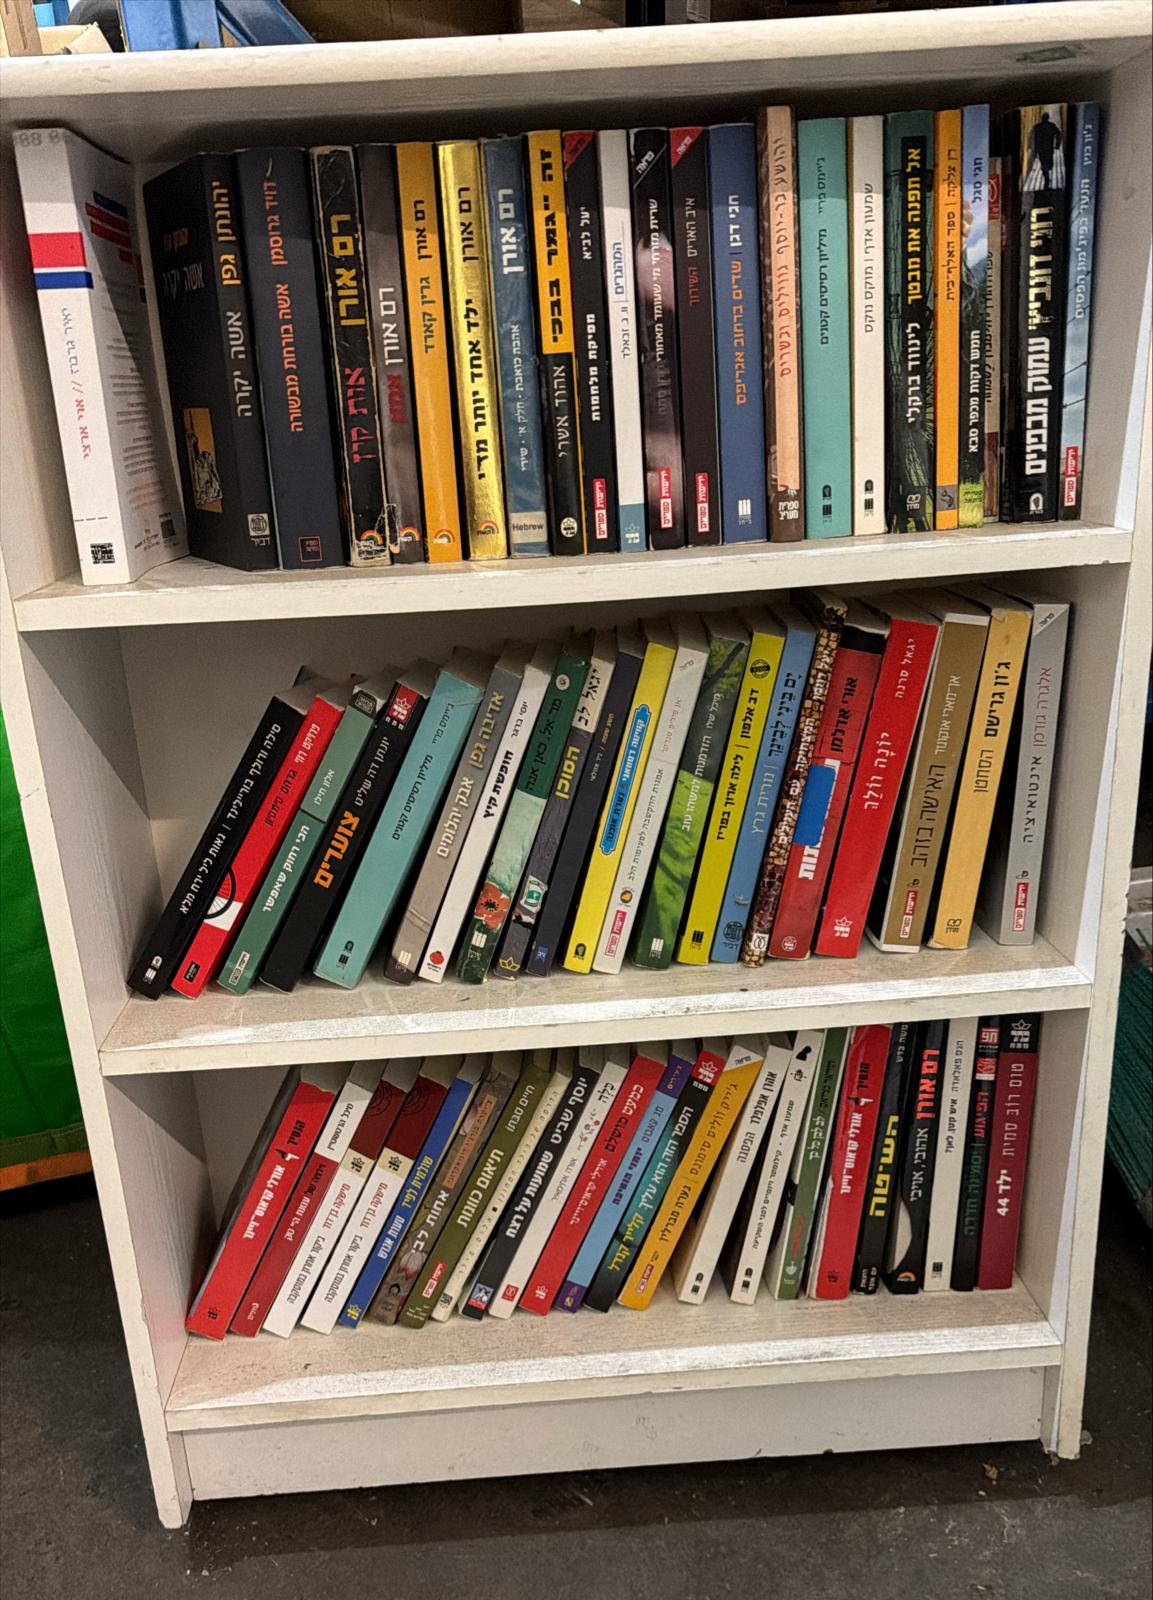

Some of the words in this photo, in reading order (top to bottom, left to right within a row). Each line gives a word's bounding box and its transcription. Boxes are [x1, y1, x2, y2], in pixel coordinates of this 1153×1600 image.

[211, 180, 236, 241] יהונתן
[263, 181, 278, 209] דויד
[457, 186, 474, 215] רם
[497, 188, 514, 221] רם
[862, 182, 874, 224] שמעון
[907, 177, 920, 222] תפנה
[266, 214, 288, 265] גרוסמן
[327, 213, 354, 258] רם
[459, 221, 478, 262] אורן
[907, 227, 920, 252] את
[1029, 206, 1053, 247] רוני
[414, 227, 431, 260] אורן
[499, 226, 524, 274] אורן
[539, 148, 553, 182] זה
[548, 277, 563, 343] בבכי
[219, 253, 241, 285] גפן
[612, 241, 624, 295] המהגרים
[730, 260, 743, 300] שדים
[864, 265, 875, 300] מוקס
[907, 257, 922, 304] מבטך
[275, 283, 292, 319] אשה
[332, 266, 365, 326] אורן
[378, 287, 396, 316] רם
[419, 275, 433, 306] גרין
[421, 310, 435, 354] קארד
[463, 298, 478, 333] ילד
[732, 304, 744, 347] ברחוב
[225, 311, 246, 359] אשה
[279, 323, 296, 369] בורחת
[381, 322, 403, 365] אורן
[507, 324, 521, 355] אהבה
[585, 313, 598, 360] מפיקת
[905, 322, 920, 371] לינווד
[467, 338, 483, 383] אחד
[1026, 336, 1052, 393] עמוק
[232, 370, 253, 417] יקרה
[344, 367, 368, 415] אות
[552, 364, 567, 407] אהוד
[588, 366, 600, 421] מלחמות
[734, 351, 746, 405] אגריפס
[284, 374, 303, 432] מבשורה
[471, 388, 486, 432] יותר
[905, 374, 923, 423] ברקלי
[555, 414, 570, 457] אשרי
[1024, 397, 1048, 475] מבפנים
[473, 438, 488, 480] מדי
[1065, 479, 1074, 502] ספרים
[512, 522, 544, 531] Hebrew
[596, 511, 606, 536] ספרים
[900, 638, 915, 664] יגאל
[580, 667, 600, 701] יגאל
[840, 676, 858, 704] אורי
[894, 669, 909, 698] סרנה
[993, 661, 1011, 686] ג'ון
[1036, 667, 1051, 709] אלגרה
[518, 700, 528, 715] יוסי
[747, 687, 759, 705] דב
[478, 691, 504, 741] אדיבה
[510, 718, 523, 737] ברגר
[572, 703, 590, 727] לב
[739, 706, 755, 739] אלפון
[829, 708, 852, 752] אדלמן
[983, 691, 1005, 737] גרישם
[1032, 714, 1047, 746] גודמן
[262, 723, 281, 749] סילה
[373, 736, 389, 762] יונתן
[794, 716, 817, 772] המצחיקה
[248, 749, 268, 776] ורולף
[366, 761, 379, 778] דה
[468, 742, 488, 770] גפן
[491, 749, 514, 795] חופשת
[554, 745, 580, 799] הסוכן
[692, 734, 712, 777] הזדמנות
[729, 753, 744, 780] לילה
[972, 749, 994, 792] הסחטן
[322, 768, 335, 788] אלון
[354, 778, 372, 806] שליט
[454, 776, 474, 808] אבק
[723, 781, 737, 807] ארוך
[919, 764, 946, 821] האישה
[313, 787, 327, 805] חילו
[482, 795, 498, 818] קיץ
[1022, 756, 1042, 843] אינטואיציה
[295, 824, 310, 843] הכי
[436, 806, 463, 859] יהלומים
[716, 810, 731, 840] בפריז
[208, 832, 226, 857] נאות
[282, 845, 300, 872] רחוק
[313, 810, 360, 888] צוערים
[910, 826, 934, 867] בזהב
[198, 857, 213, 874] ליל
[190, 874, 203, 892] ירח
[262, 871, 286, 912] שאפשר
[178, 892, 195, 914] מלא
[900, 916, 911, 937] ספרים
[920, 1048, 940, 1074] רם
[954, 1040, 964, 1056] הנס
[761, 1070, 777, 1092] אהרן
[951, 1057, 962, 1092] פאלאדה
[1008, 1063, 1024, 1087] טום
[518, 1084, 535, 1106] חיים
[567, 1076, 592, 1109] יוסף
[749, 1093, 770, 1124] אפלפלד
[915, 1078, 936, 1120] אורן
[948, 1098, 958, 1115] איש
[549, 1108, 574, 1144] שביט
[671, 1105, 694, 1137] הספר
[783, 1099, 794, 1122] שמעון
[973, 1091, 989, 1138] הפיגוע
[604, 1116, 628, 1152] מושלם
[779, 1122, 789, 1138] אדף
[1001, 1122, 1018, 1156] סמית
[661, 1138, 679, 1162] הזה
[688, 1140, 711, 1176] סימונס
[736, 1131, 756, 1163] הפסגה
[769, 1149, 782, 1178] קילומטר
[266, 1164, 285, 1188] אורלי
[410, 1155, 433, 1189] שולמית
[475, 1148, 504, 1189] תיאום
[524, 1150, 553, 1197] שמועות
[651, 1161, 668, 1184] הוא
[868, 1114, 899, 1216] השיטה
[968, 1150, 982, 1193] יסמינה
[995, 1168, 1012, 1194] ילד
[401, 1187, 418, 1208] לפיד
[762, 1179, 774, 1205] ויומיים
[909, 1170, 924, 1202] אויבי
[425, 1189, 449, 1227] אחות
[456, 1189, 483, 1228] כוונות
[513, 1196, 531, 1213] על
[758, 1204, 767, 1220] לפני
[964, 1198, 978, 1235] חדרה
[996, 1197, 1010, 1216] 44
[386, 1214, 405, 1238] טעות
[410, 1229, 429, 1253] לבי
[505, 1213, 524, 1238] רצח
[620, 1212, 644, 1241] קלייר
[751, 1221, 764, 1249] השקיעה
[376, 1236, 394, 1260] אנוש
[607, 1243, 631, 1271] קנדל
